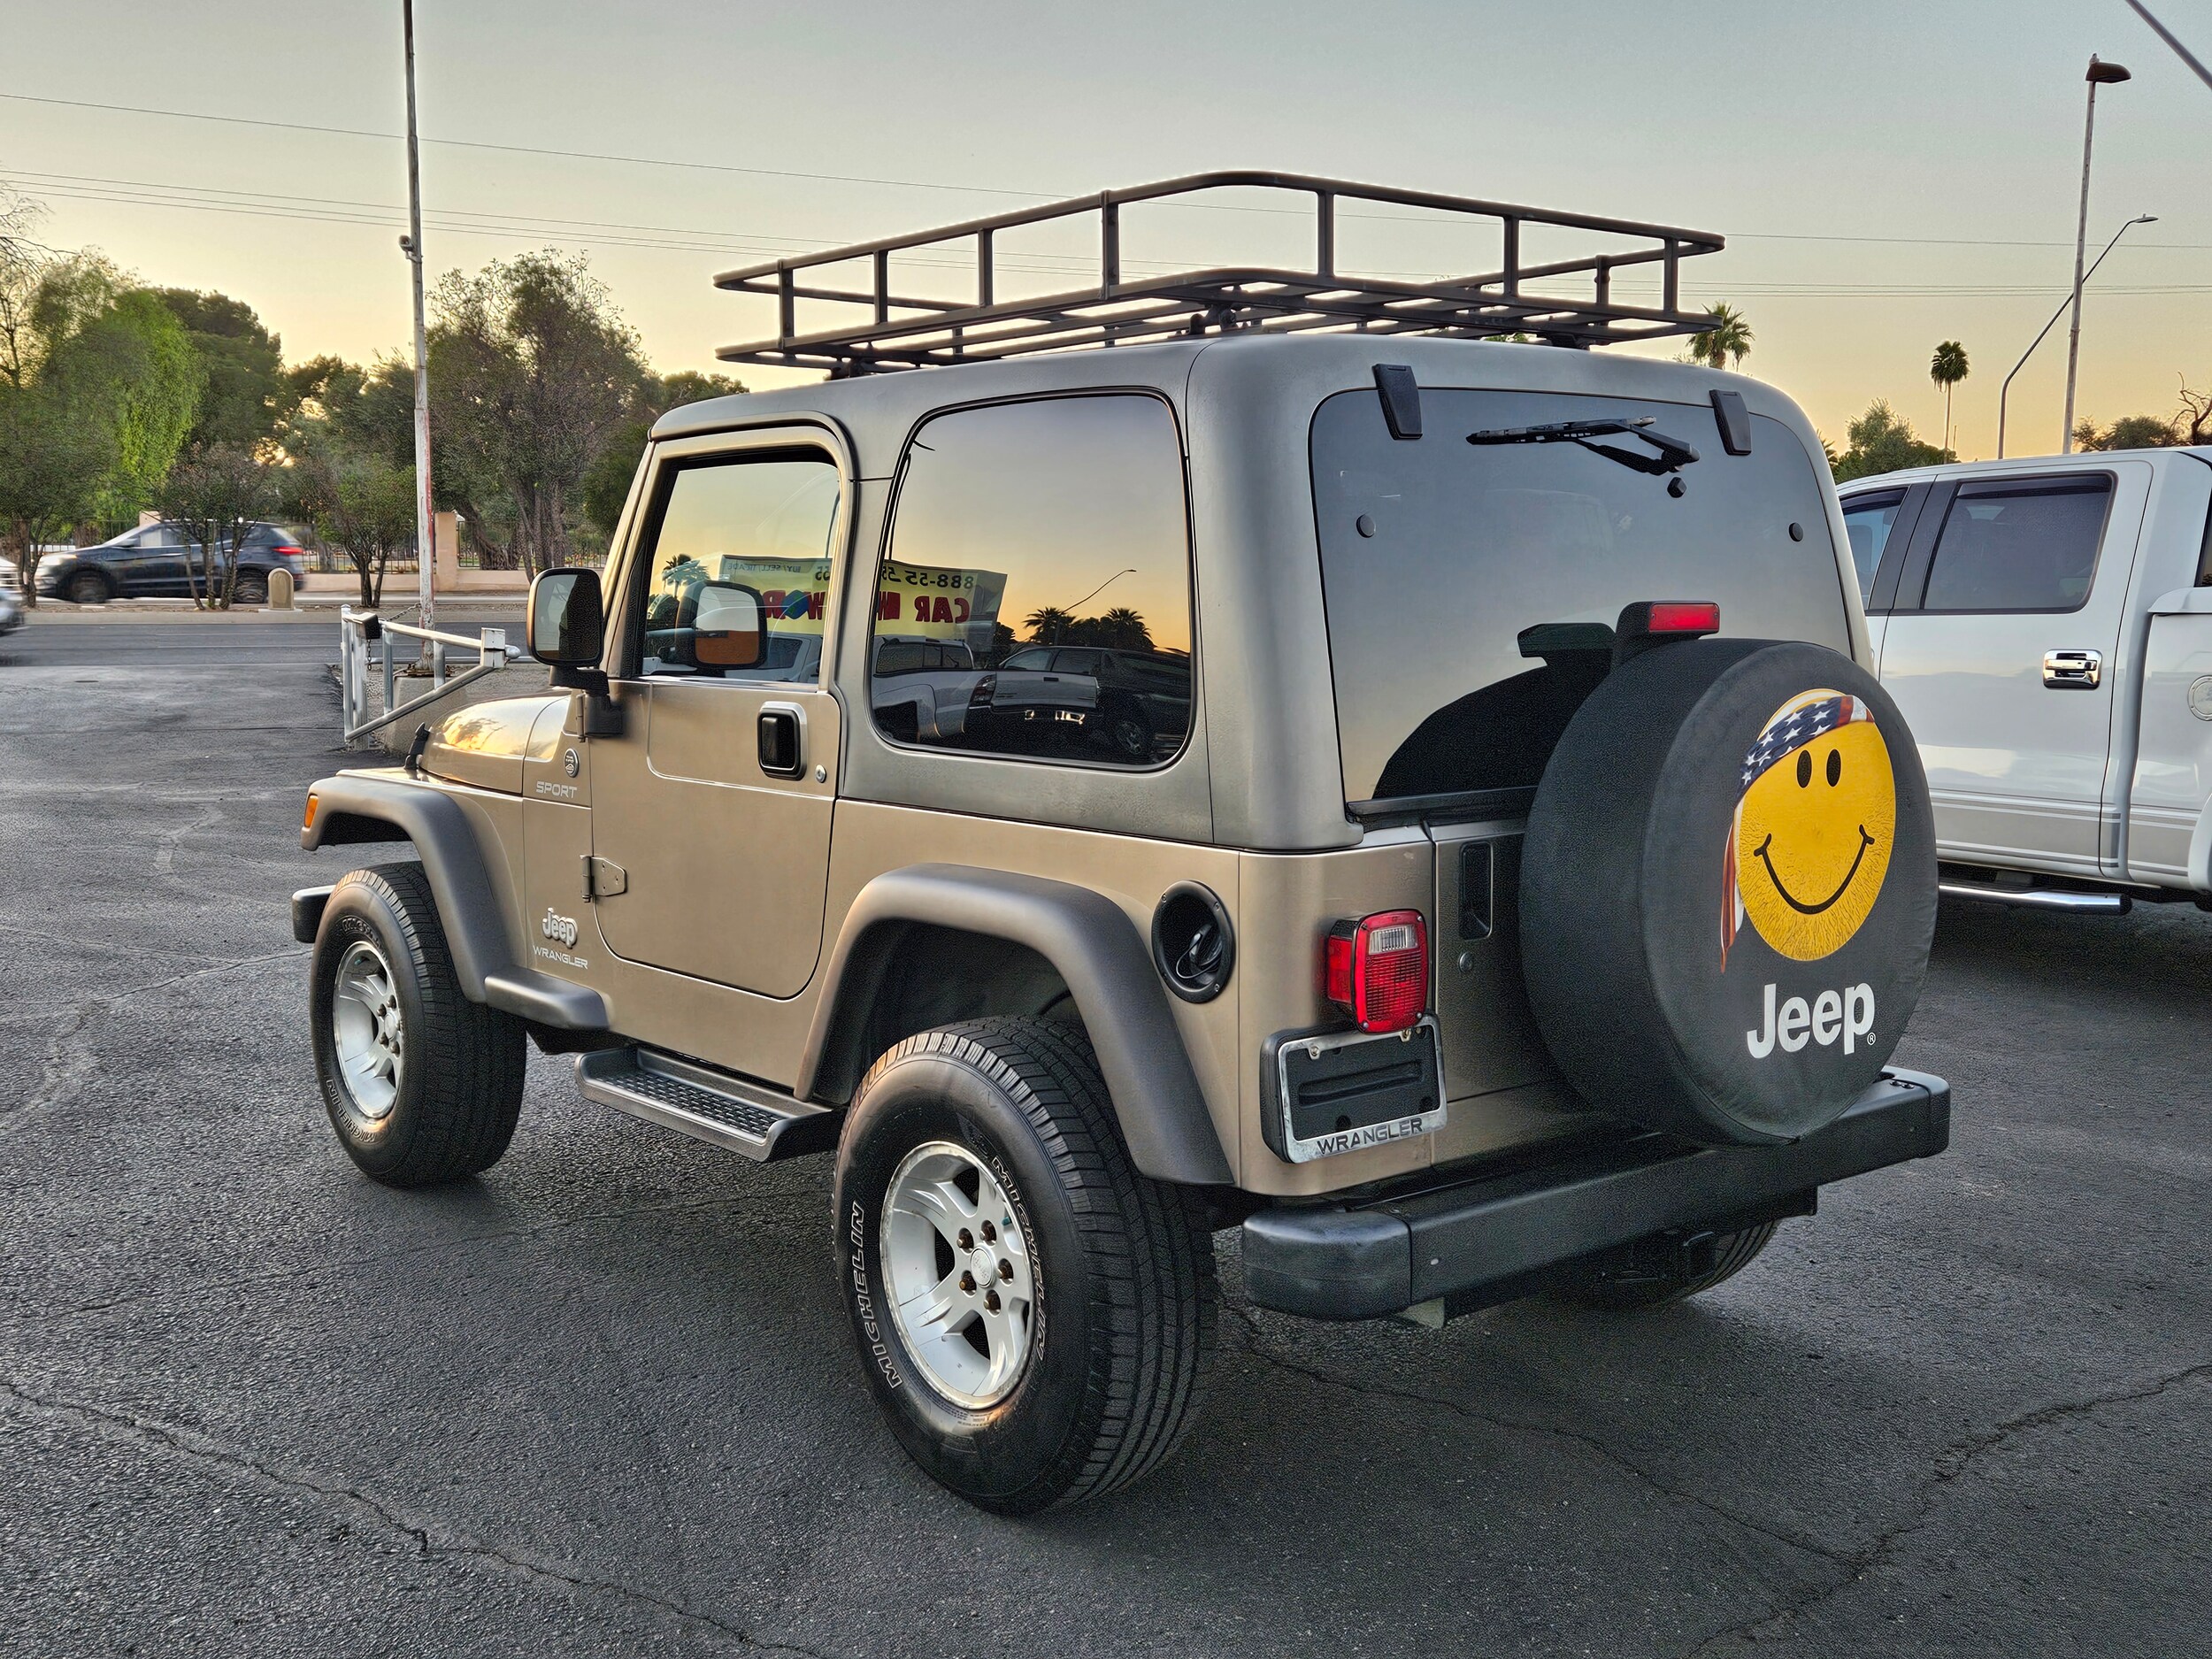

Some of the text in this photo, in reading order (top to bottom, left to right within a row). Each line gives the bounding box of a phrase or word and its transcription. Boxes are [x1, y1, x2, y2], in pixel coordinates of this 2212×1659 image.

[535, 780, 578, 799] SPORT
[541, 907, 579, 949] Jeep
[532, 944, 588, 970] WRANGLER
[325, 1079, 377, 1142] MICHELIN
[1317, 1117, 1423, 1155] WRANGLER
[850, 1200, 903, 1389] MICHELIN
